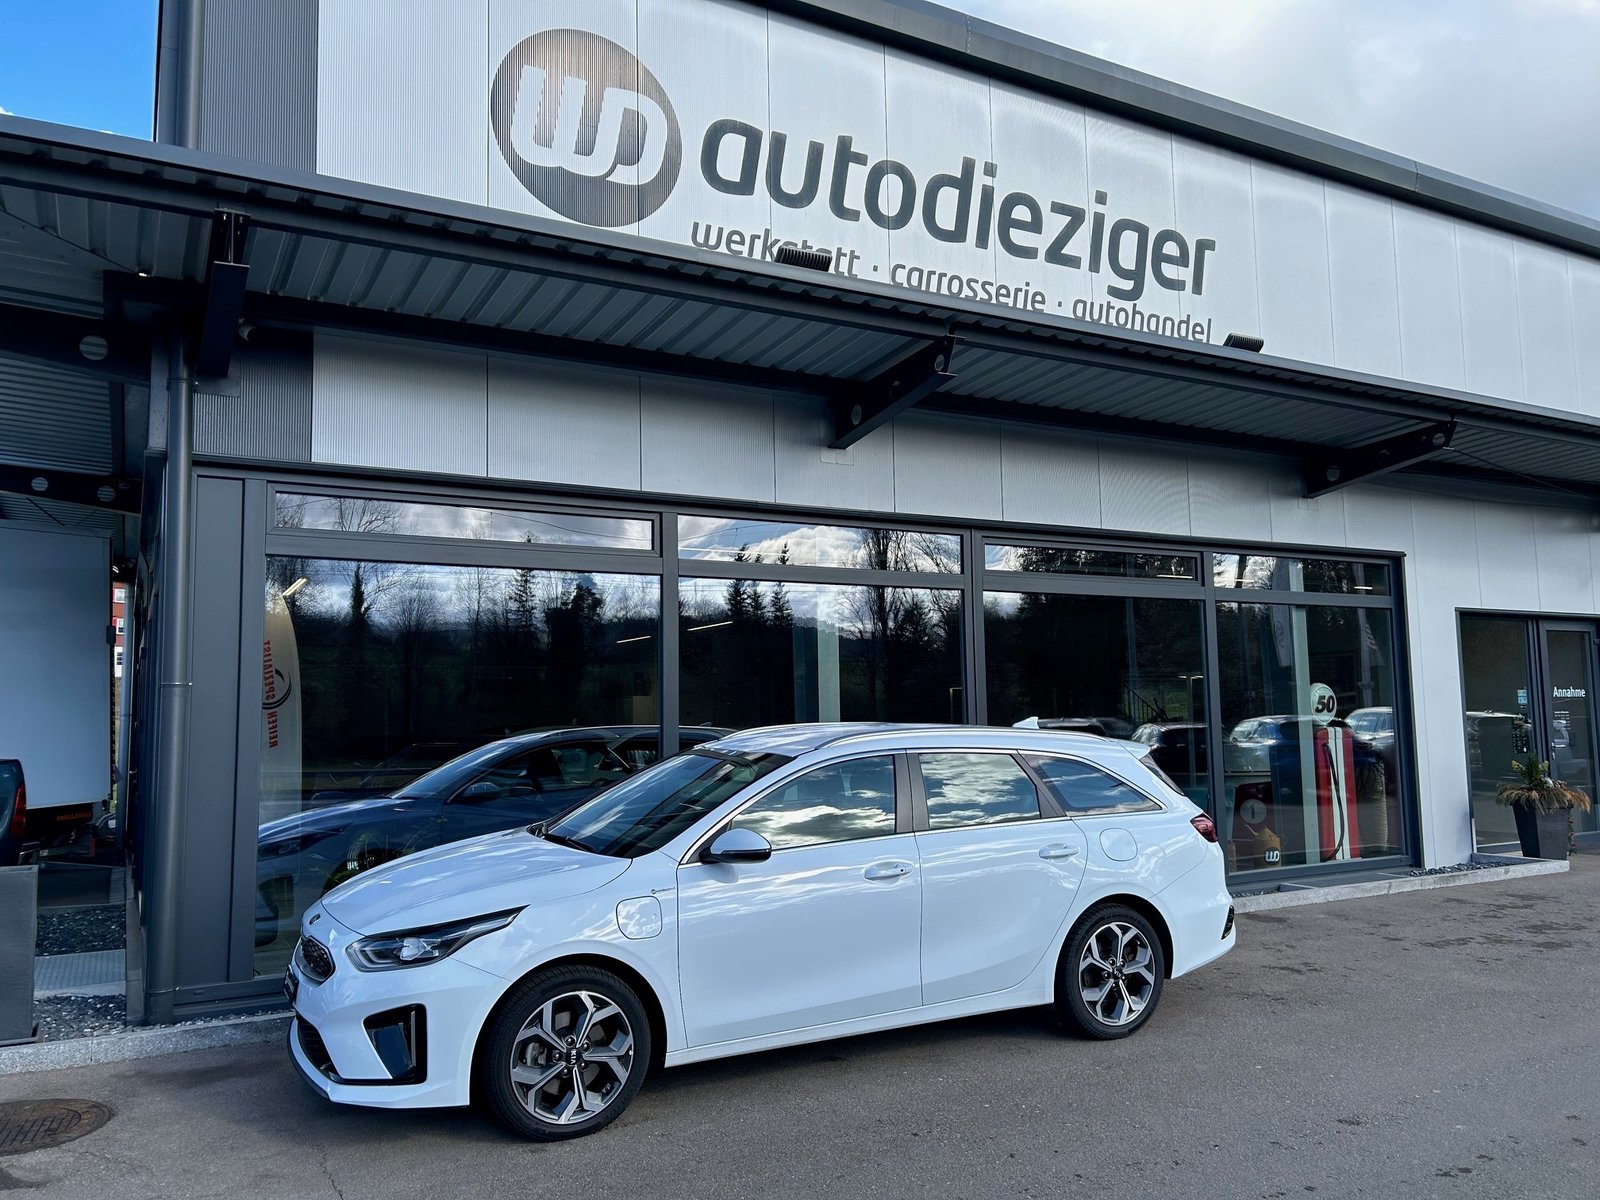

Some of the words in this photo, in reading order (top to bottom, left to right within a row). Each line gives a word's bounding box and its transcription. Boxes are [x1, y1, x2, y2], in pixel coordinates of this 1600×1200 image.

[700, 118, 1216, 301] autodieziger
[890, 263, 1046, 312] carrosserie
[1072, 298, 1212, 343] autohandel
[1315, 694, 1335, 713] 50
[1553, 686, 1586, 697] Annahme
